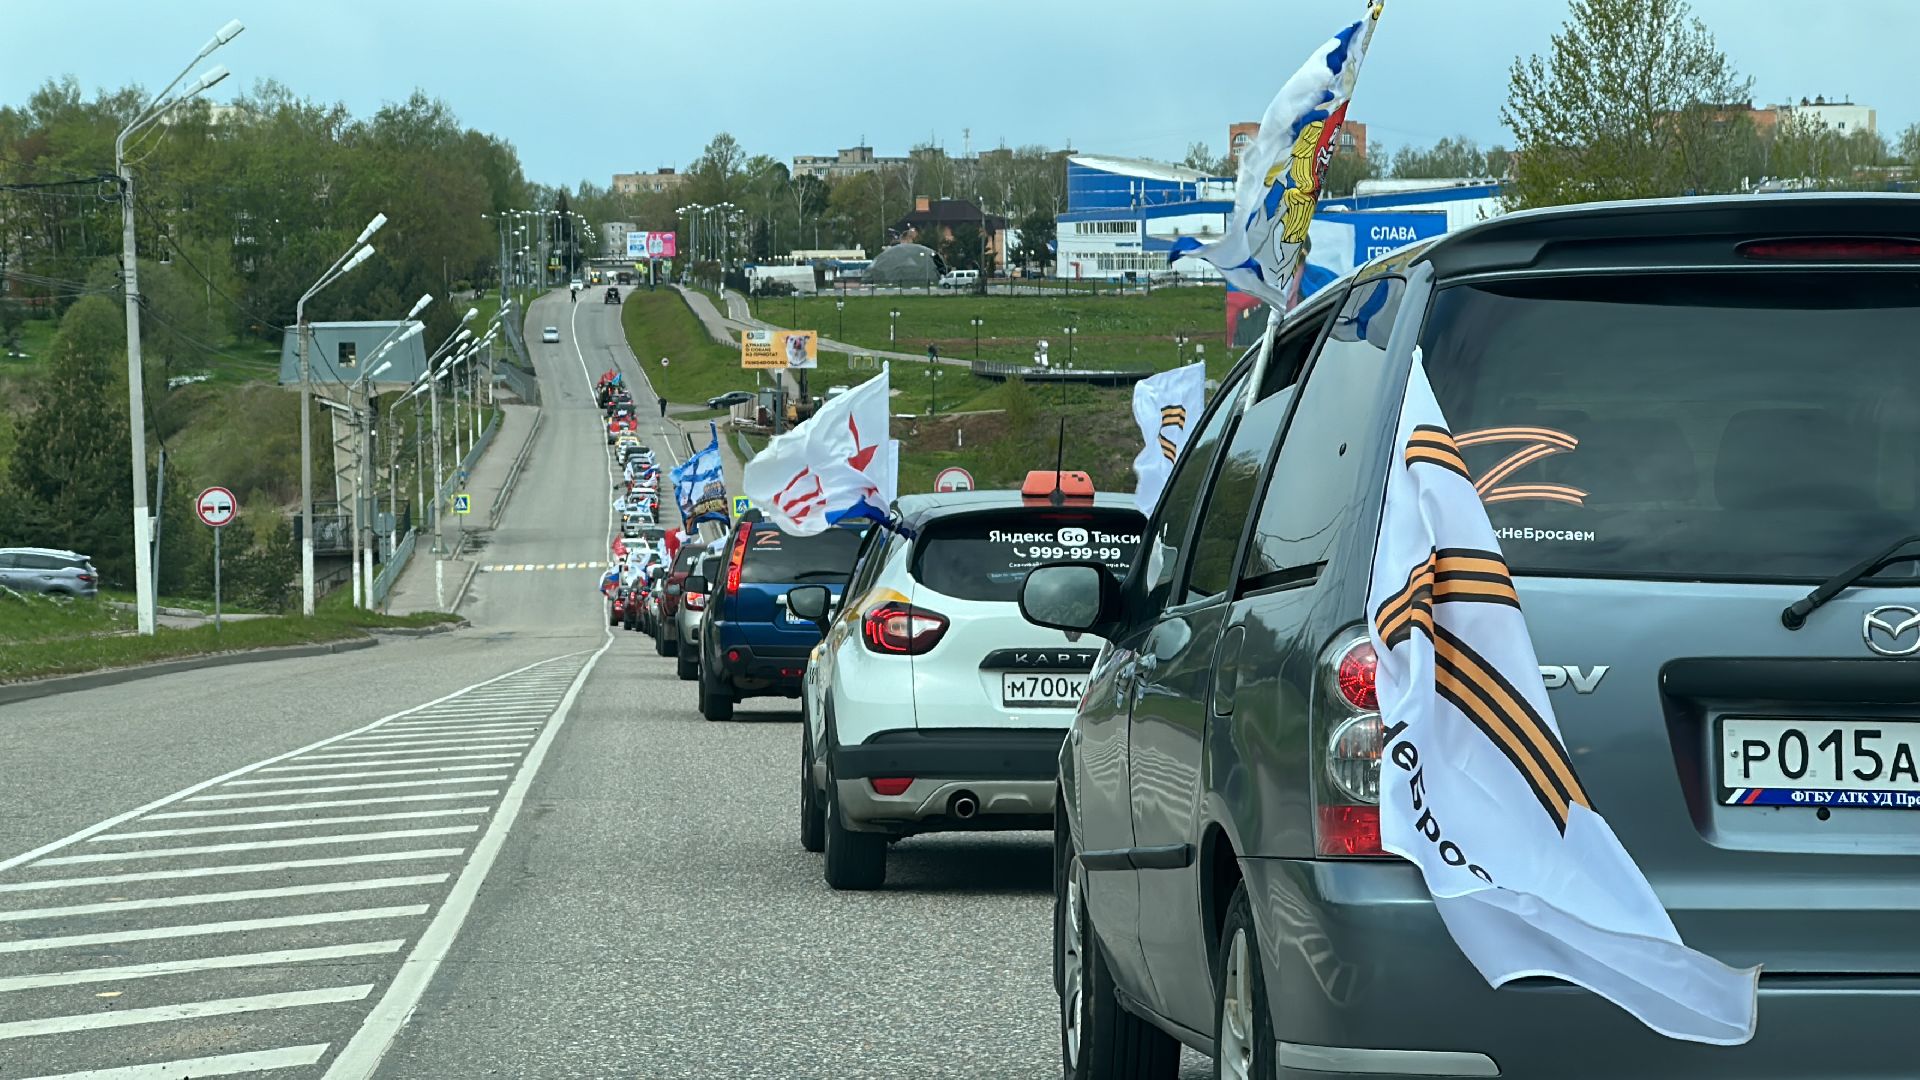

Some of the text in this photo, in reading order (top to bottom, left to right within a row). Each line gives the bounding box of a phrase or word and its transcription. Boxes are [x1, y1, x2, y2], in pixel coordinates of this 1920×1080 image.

[1370, 226, 1417, 240] СЛАВА
[1367, 246, 1396, 261] ГЕР
[989, 530, 1141, 544] Яндекс Go Такси
[1029, 546, 1121, 560] 999-99-99
[1015, 653, 1091, 663] КАРТ
[1011, 677, 1082, 698] М700К
[1742, 728, 1919, 783] Р015А
[1791, 791, 1834, 804] ФГБУ
[1838, 791, 1868, 804] АТК
[1873, 792, 1893, 806] УД
